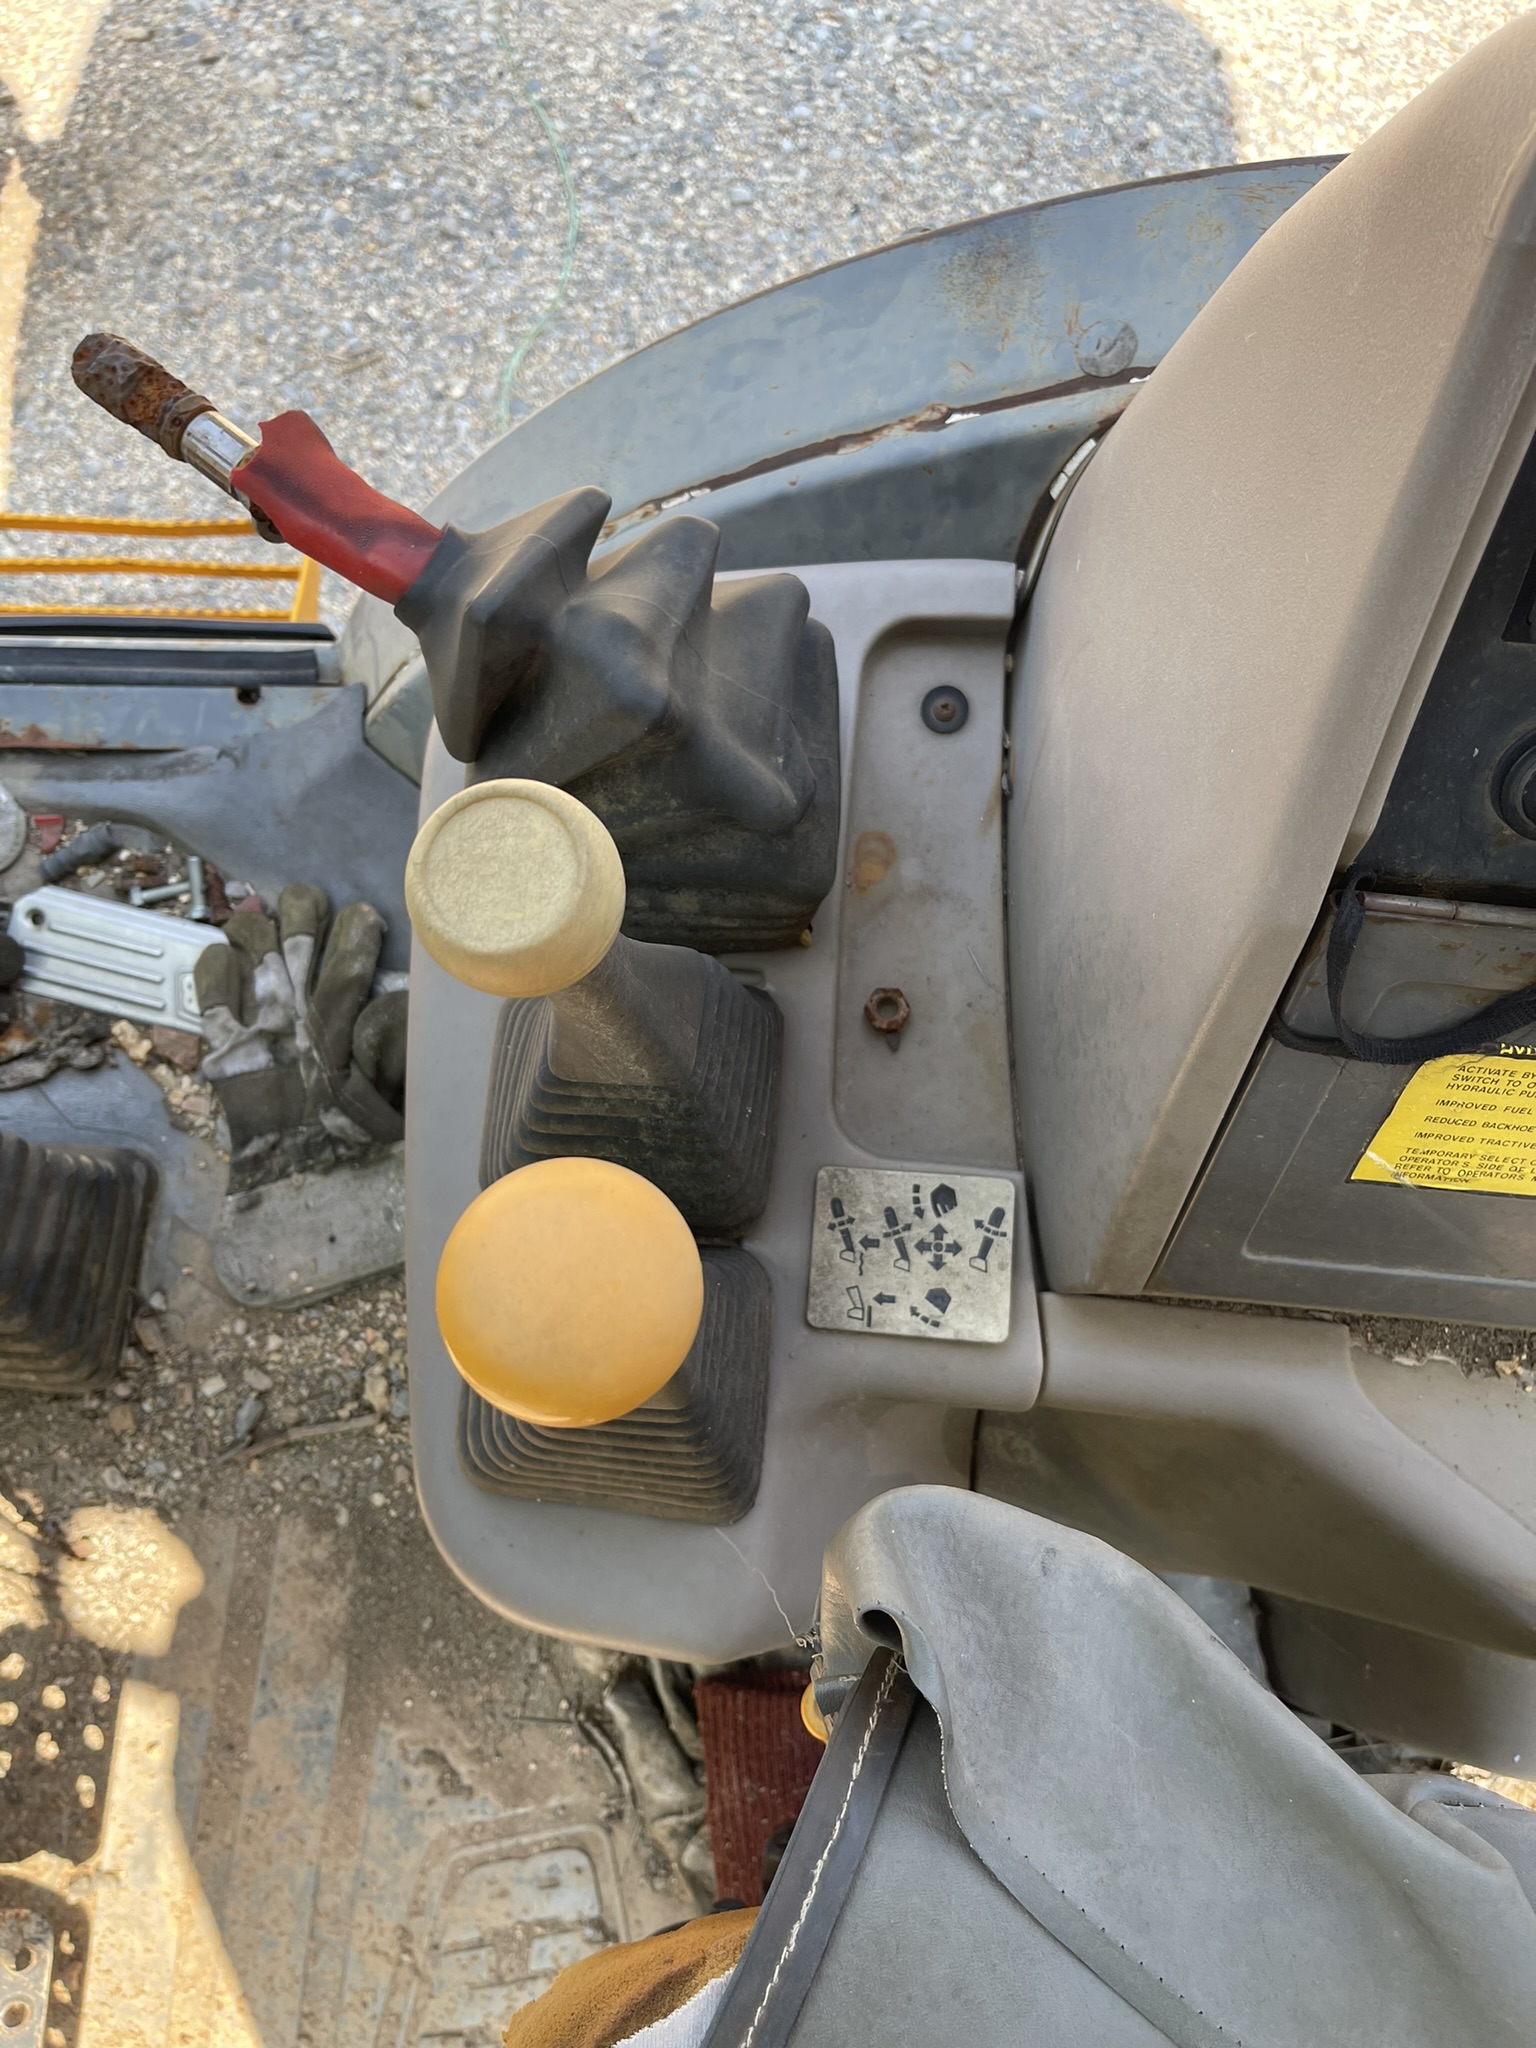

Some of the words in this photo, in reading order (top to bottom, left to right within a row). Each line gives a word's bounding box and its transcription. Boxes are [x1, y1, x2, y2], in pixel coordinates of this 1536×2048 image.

[1458, 1065, 1517, 1078] ACTIVATE
[1521, 1071, 1536, 1080] BY
[1451, 1073, 1500, 1086] SWITCH
[1506, 1079, 1522, 1088] TO
[1446, 1082, 1516, 1097] HYDRAULIC
[1435, 1098, 1498, 1112] IMPROVED
[1503, 1105, 1533, 1116] FUEL
[1424, 1115, 1478, 1128] REDUCED
[1481, 1121, 1536, 1133] BACKHOE
[1414, 1131, 1475, 1144] IMPROVED
[1479, 1137, 1536, 1150] TRACTIVE
[1405, 1146, 1475, 1160] TEMPORARY
[1479, 1154, 1527, 1165] SELECT
[1394, 1162, 1432, 1172] REFER
[1437, 1166, 1451, 1176] TO
[1476, 1162, 1504, 1172] SIDE
[1509, 1165, 1526, 1174] OF
